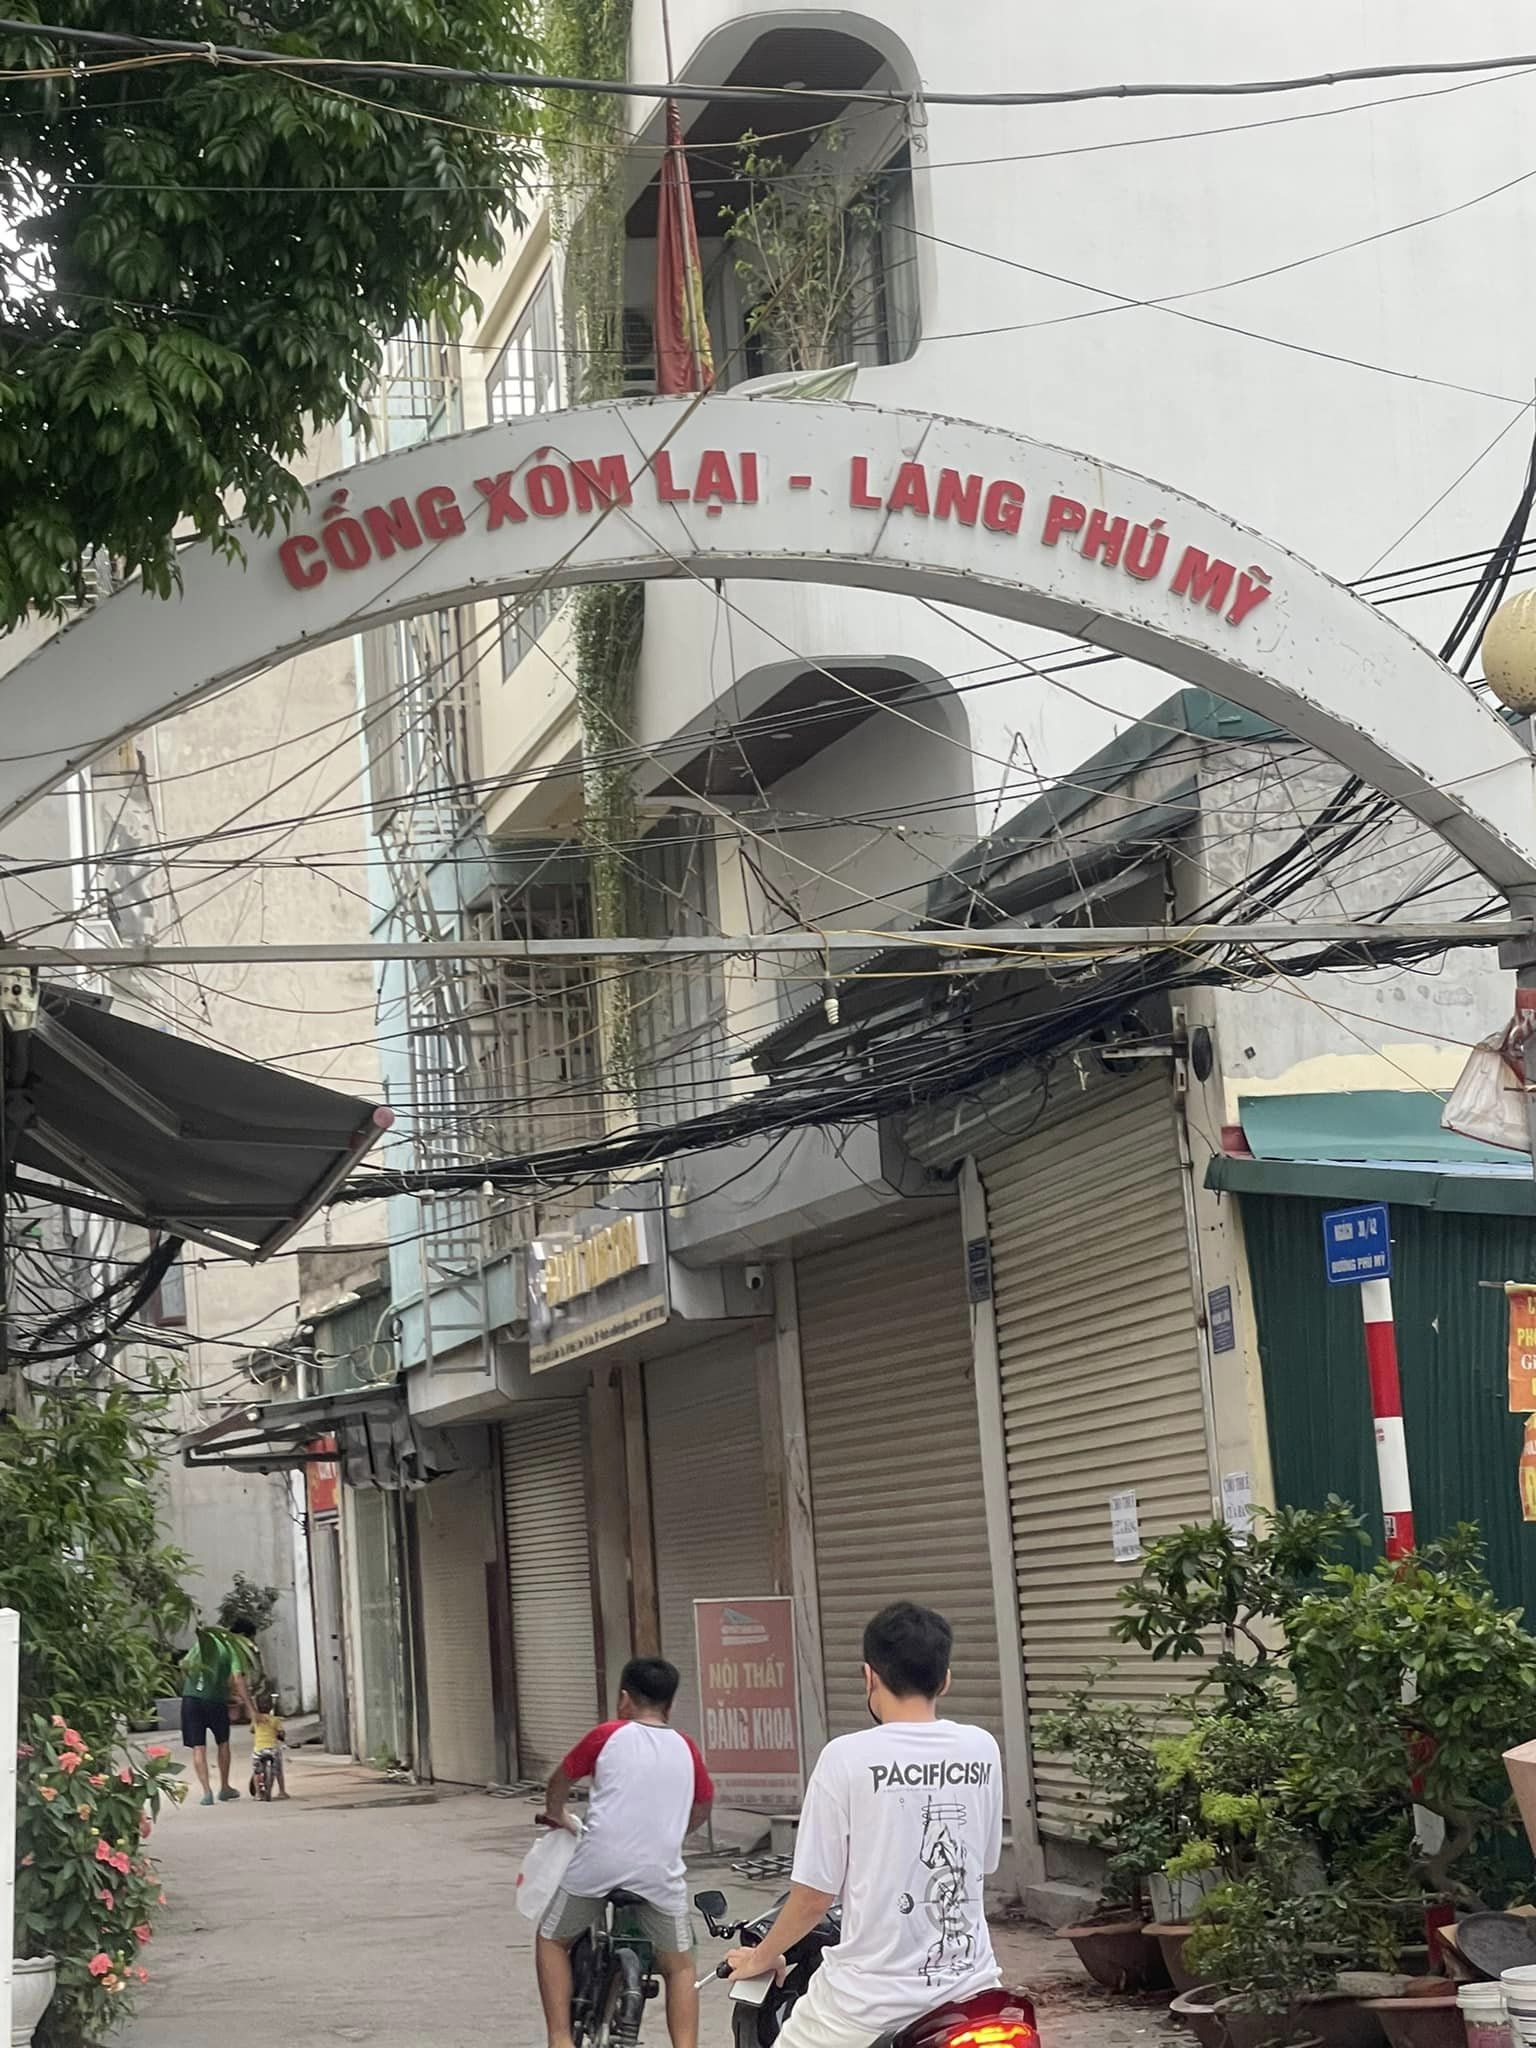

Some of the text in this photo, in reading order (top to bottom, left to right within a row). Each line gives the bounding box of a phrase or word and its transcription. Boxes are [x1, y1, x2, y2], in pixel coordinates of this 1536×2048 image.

[473, 446, 634, 533] XÓM
[652, 450, 760, 517] LẠI
[1040, 494, 1170, 581] PHÚ
[1168, 544, 1273, 626] MỸ
[751, 1706, 796, 1752] KHOA
[867, 1758, 993, 1795] PACIFICISM
